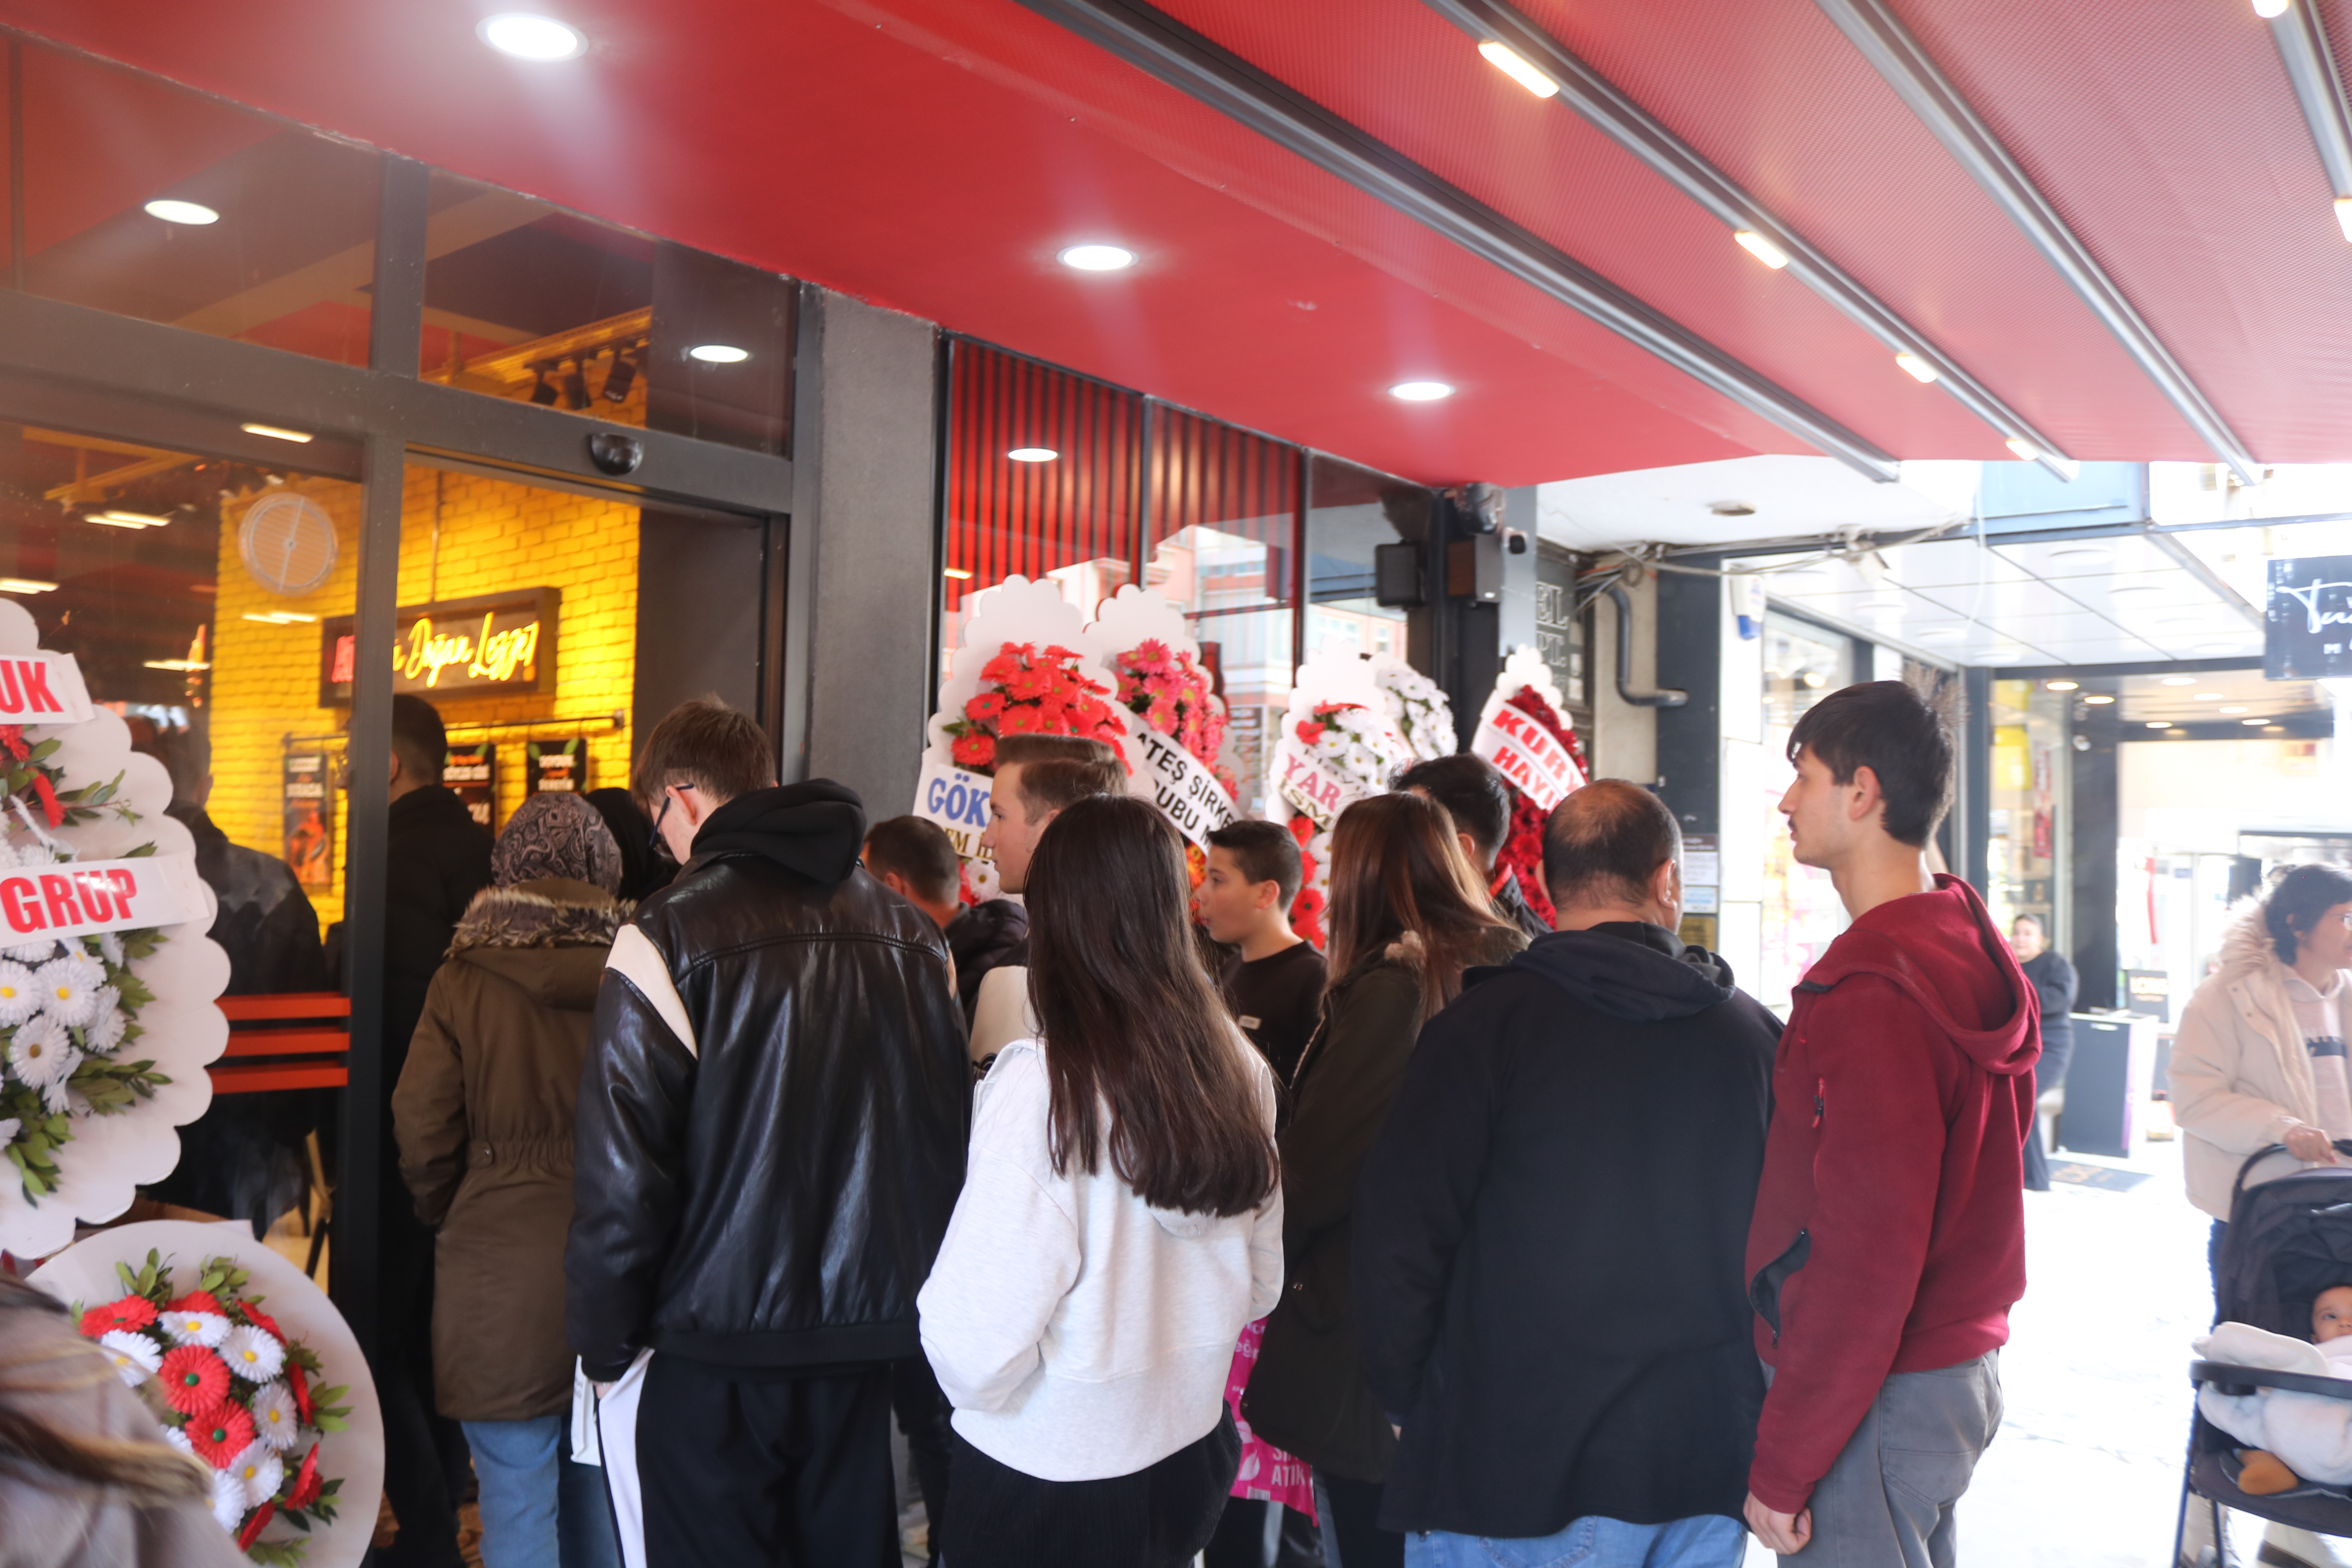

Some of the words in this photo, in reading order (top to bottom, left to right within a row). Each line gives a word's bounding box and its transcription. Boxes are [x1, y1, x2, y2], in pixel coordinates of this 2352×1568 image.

[928, 773, 991, 828] GÖK
[1154, 780, 1200, 830] UBU
[0, 868, 137, 933] GRUP
[1270, 1465, 1306, 1488] ATIK
